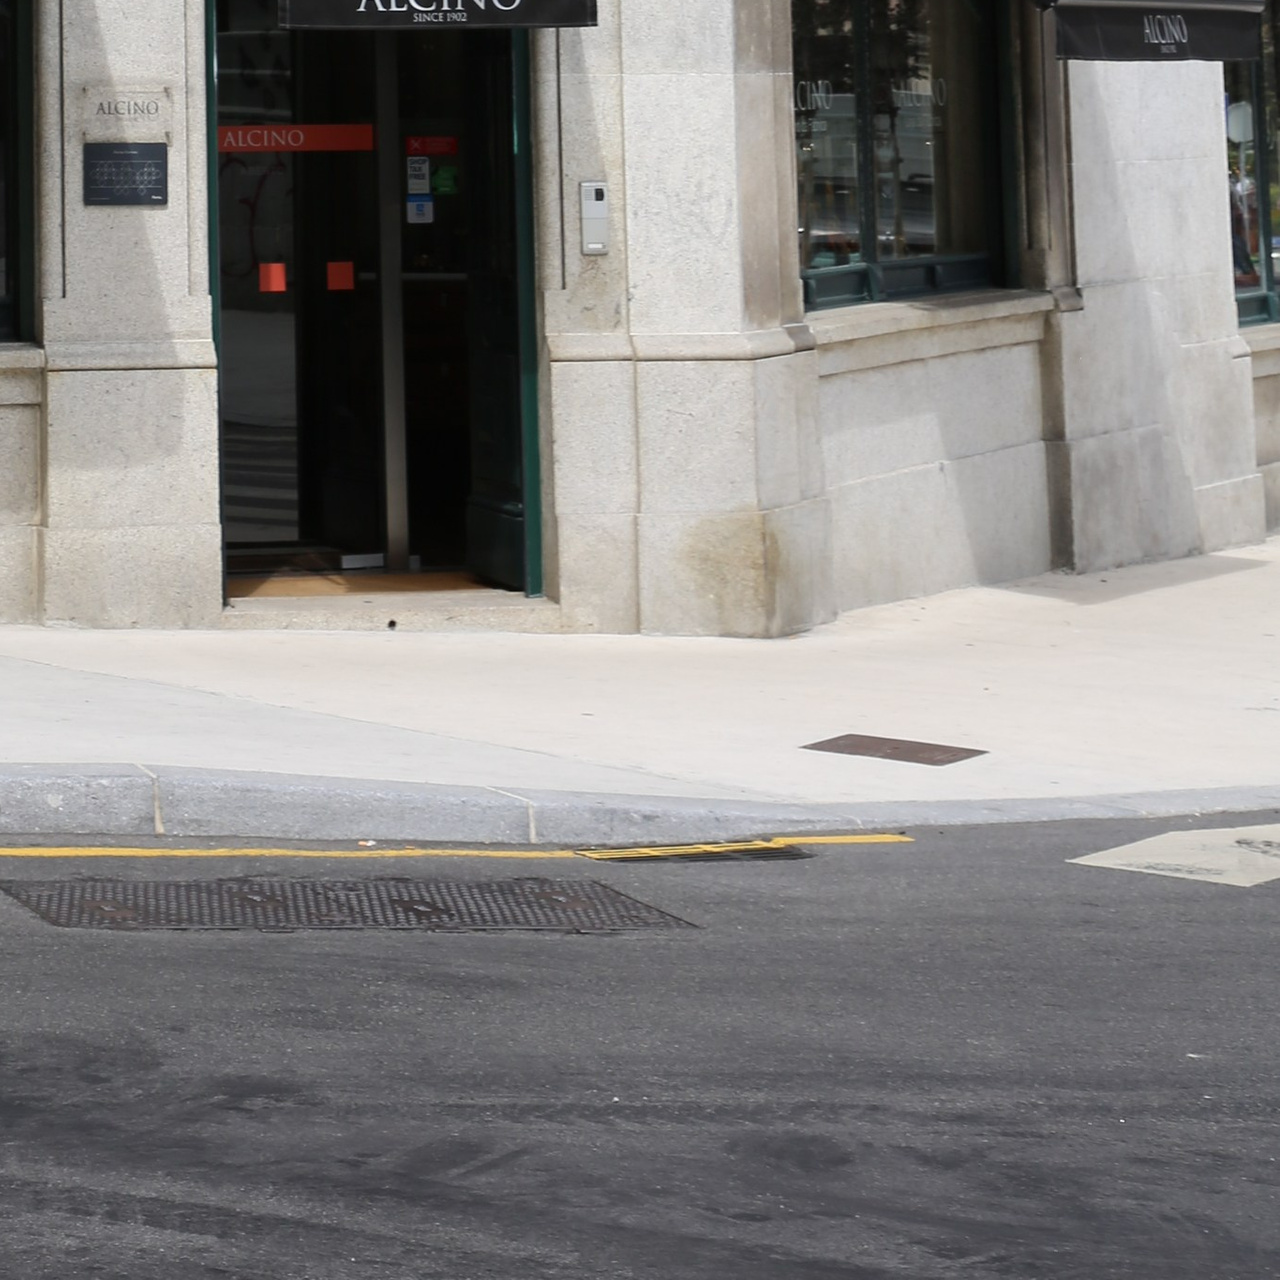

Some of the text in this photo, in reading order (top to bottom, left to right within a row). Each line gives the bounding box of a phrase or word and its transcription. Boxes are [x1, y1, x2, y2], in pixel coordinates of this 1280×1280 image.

[412, 12, 468, 23] SINCE 1902
[1143, 14, 1189, 44] ALCINO
[794, 80, 833, 111] CINO
[96, 100, 160, 116] ALCINO
[223, 129, 304, 148] ALCINO
